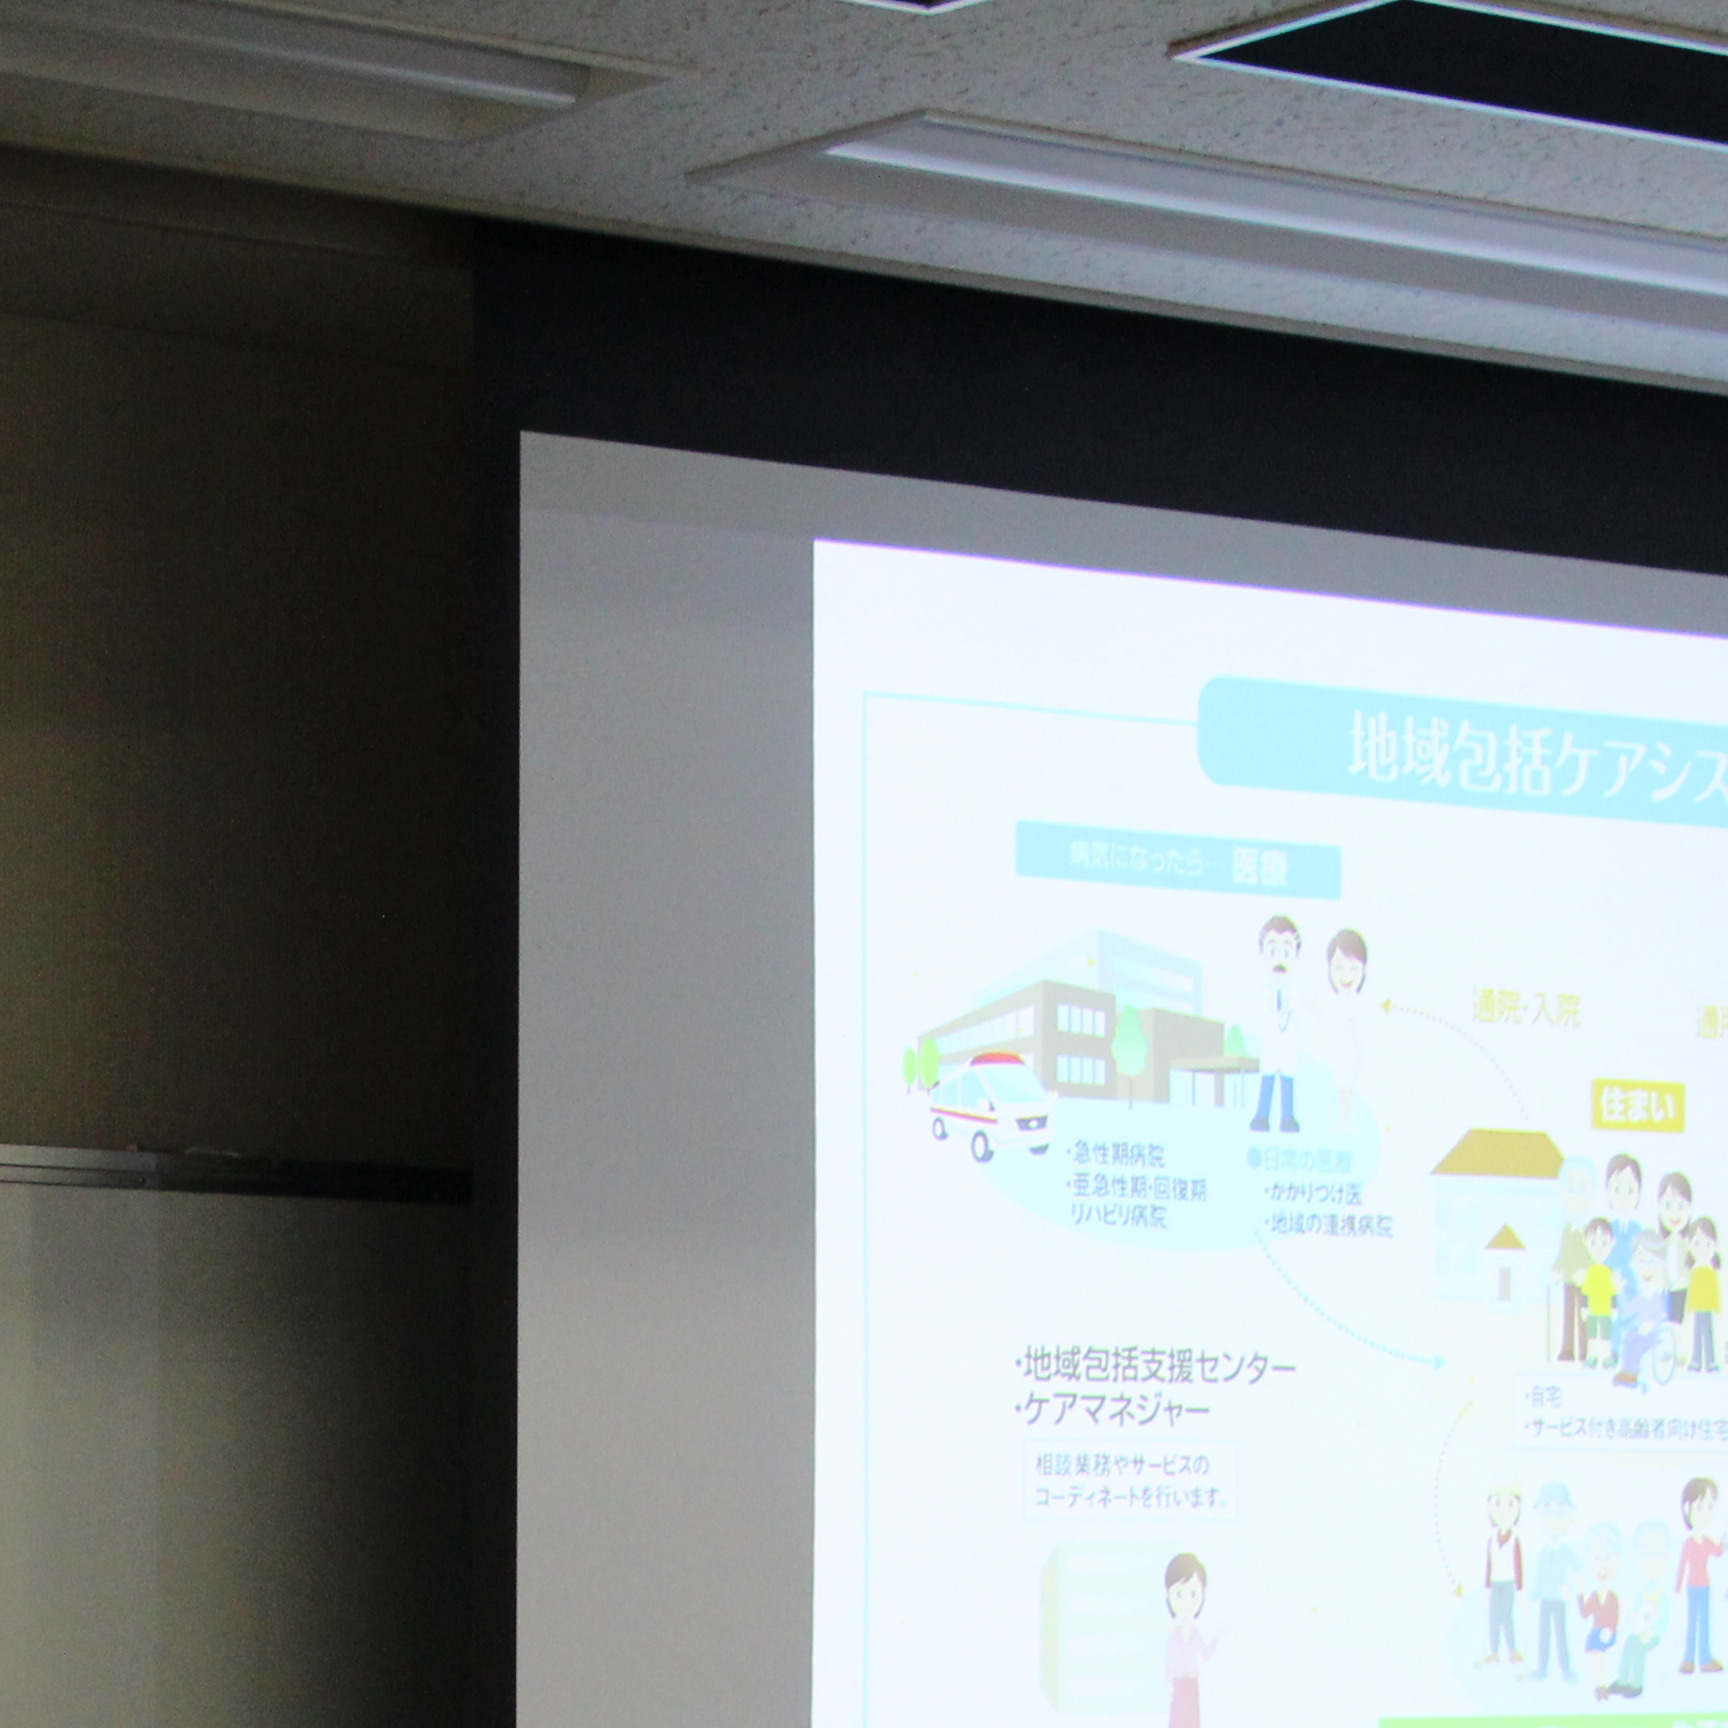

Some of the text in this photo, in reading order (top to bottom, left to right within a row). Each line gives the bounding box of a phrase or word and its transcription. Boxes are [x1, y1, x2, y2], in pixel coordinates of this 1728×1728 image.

[1232, 847, 1288, 886] 医療
[1472, 986, 1582, 1028] 通院・入院
[1600, 1085, 1676, 1123] 住まい
[1071, 1204, 1168, 1230] リハビリ病院
[1015, 1344, 1297, 1385] ・地域包括支援センター
[1014, 1390, 1211, 1428] ・ケアマネジャー
[1036, 1452, 1211, 1477] 相談業務やサービスの
[1036, 1483, 1229, 1510] コーディネートを行います。
